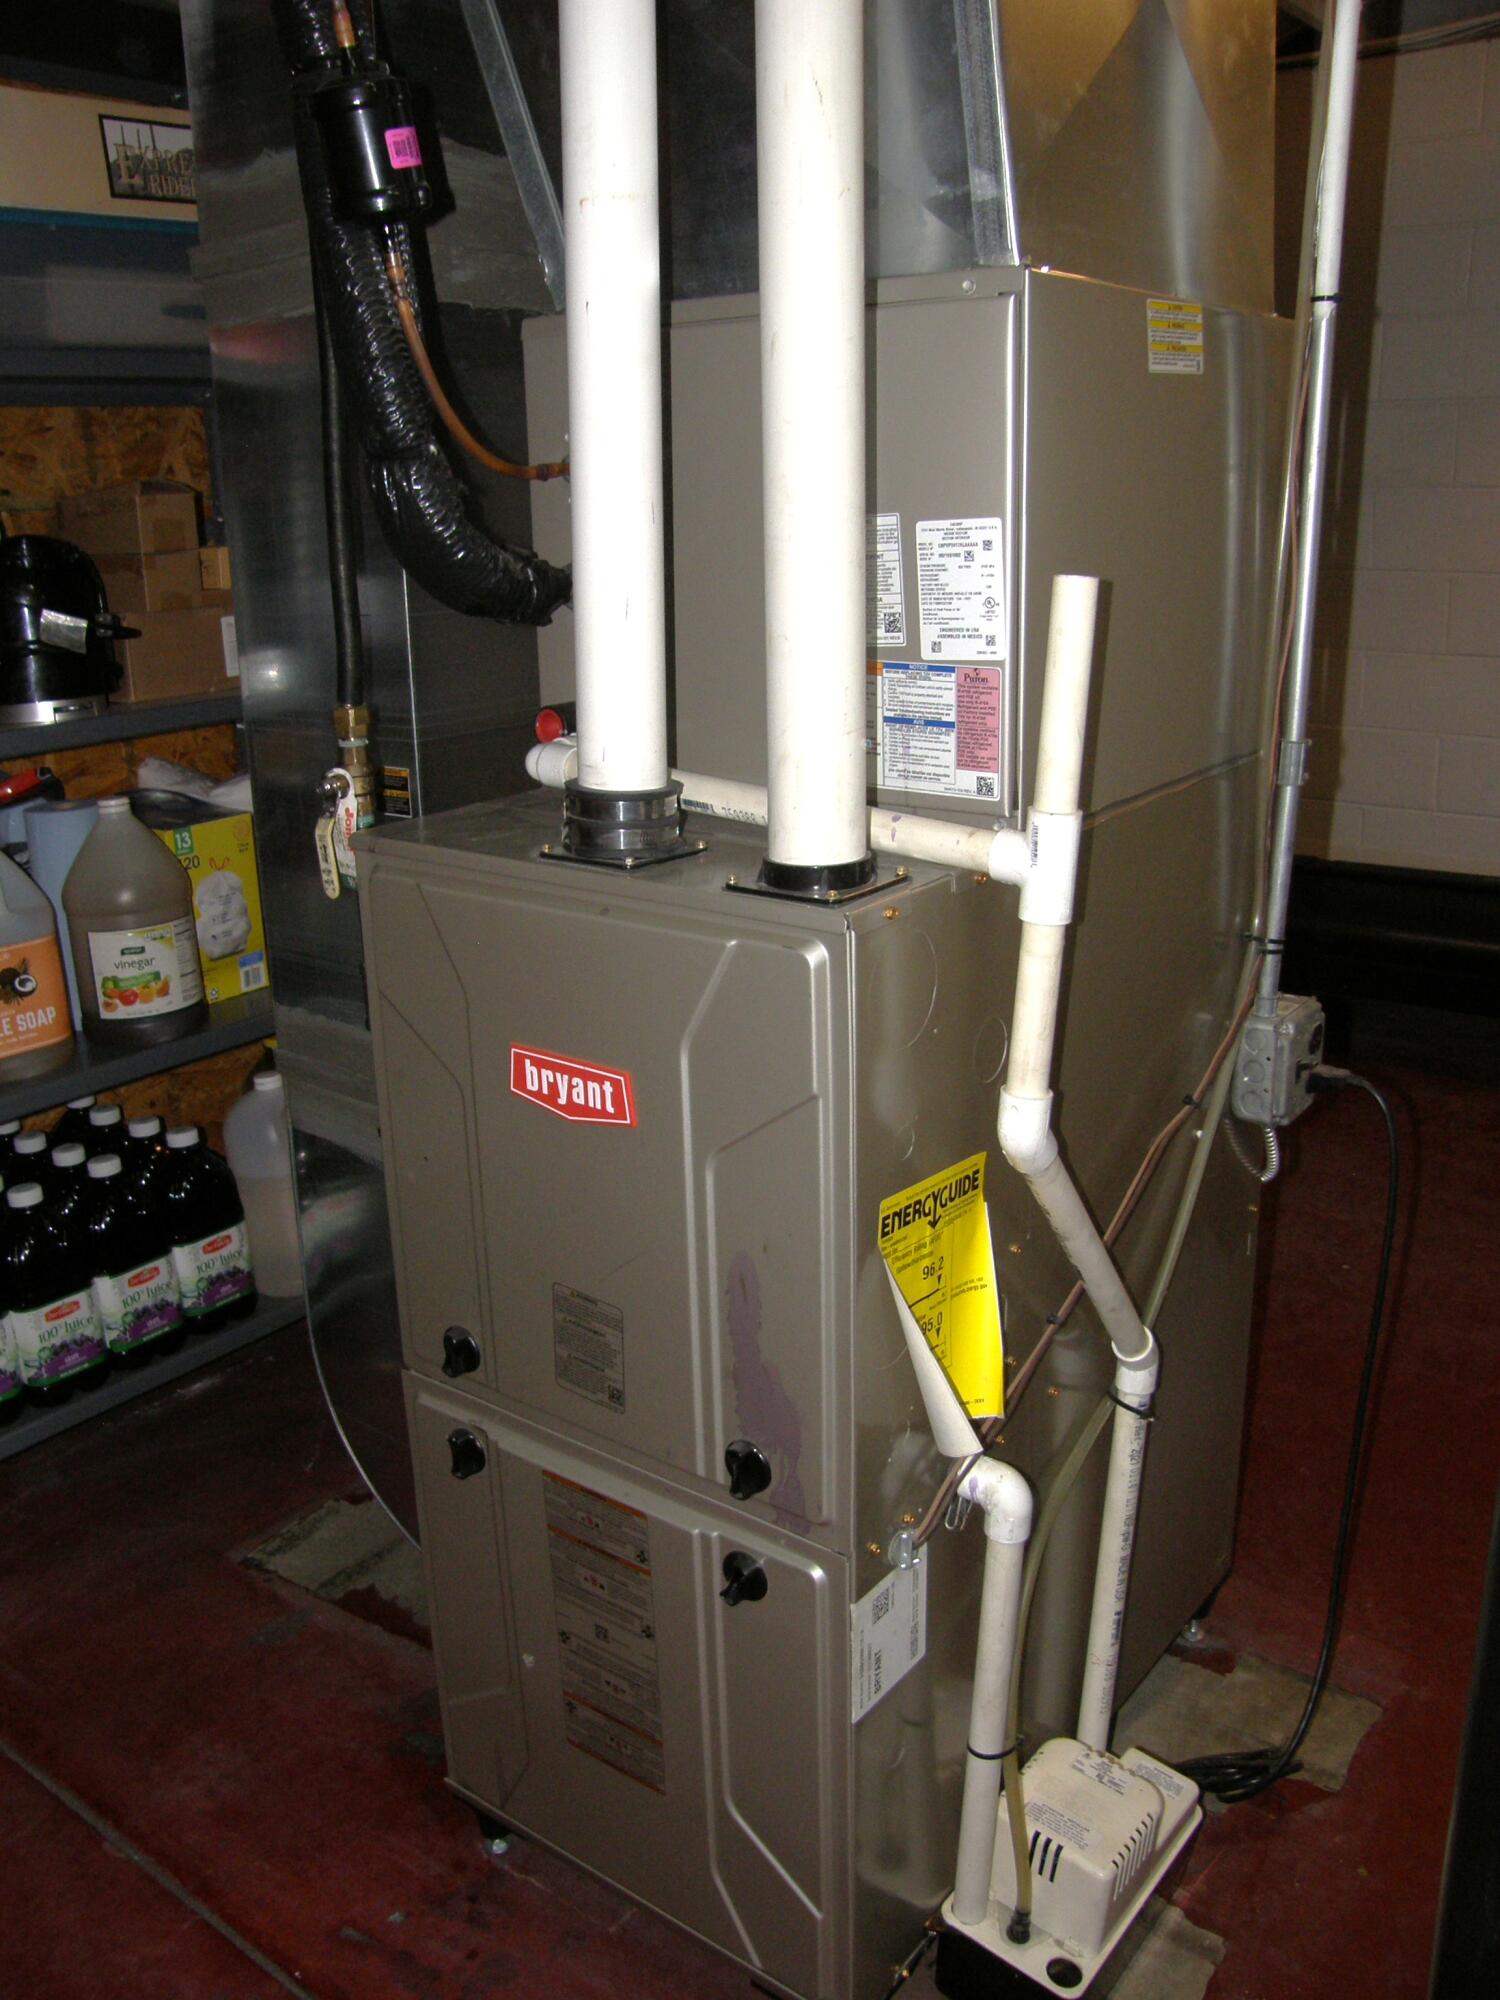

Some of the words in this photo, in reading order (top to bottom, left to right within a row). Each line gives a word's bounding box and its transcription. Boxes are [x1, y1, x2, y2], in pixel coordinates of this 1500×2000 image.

[150, 175, 196, 196] RIDE
[963, 673, 989, 683] Puron
[175, 831, 192, 850] 13
[113, 957, 156, 971] vinegar
[0, 1017, 14, 1037] E
[16, 1006, 57, 1032] SOAP
[524, 1058, 615, 1114] bryant
[880, 1168, 980, 1239] ENERGYGUIDE
[219, 1249, 243, 1266] Juice
[922, 1256, 945, 1280] 96.2
[146, 1281, 173, 1298] Juice
[64, 1316, 94, 1336] Juice
